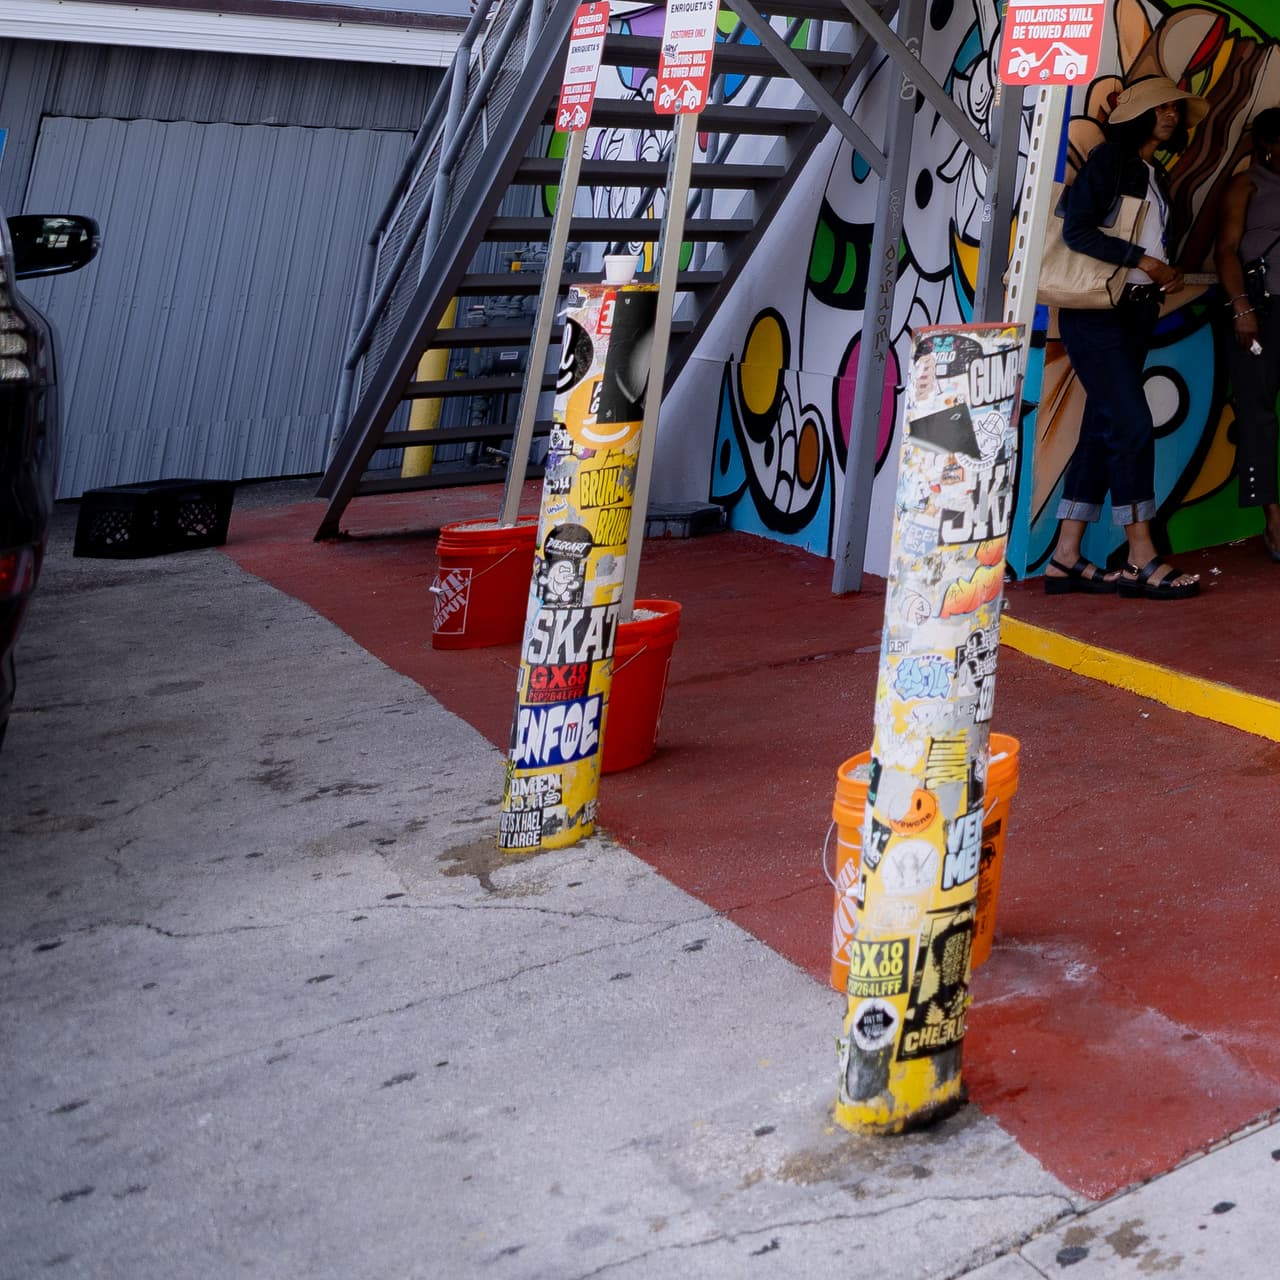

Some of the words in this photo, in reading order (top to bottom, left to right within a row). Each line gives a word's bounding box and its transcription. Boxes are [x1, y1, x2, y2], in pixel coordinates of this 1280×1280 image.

[671, 1, 713, 13] ENRIQUETA'S
[1015, 9, 1067, 23] VIOLATORS
[1069, 7, 1094, 21] WILL
[1012, 27, 1026, 39] BE
[1027, 25, 1062, 39] TOWED
[1063, 24, 1093, 38] AWAY
[516, 695, 598, 765] INFOE
